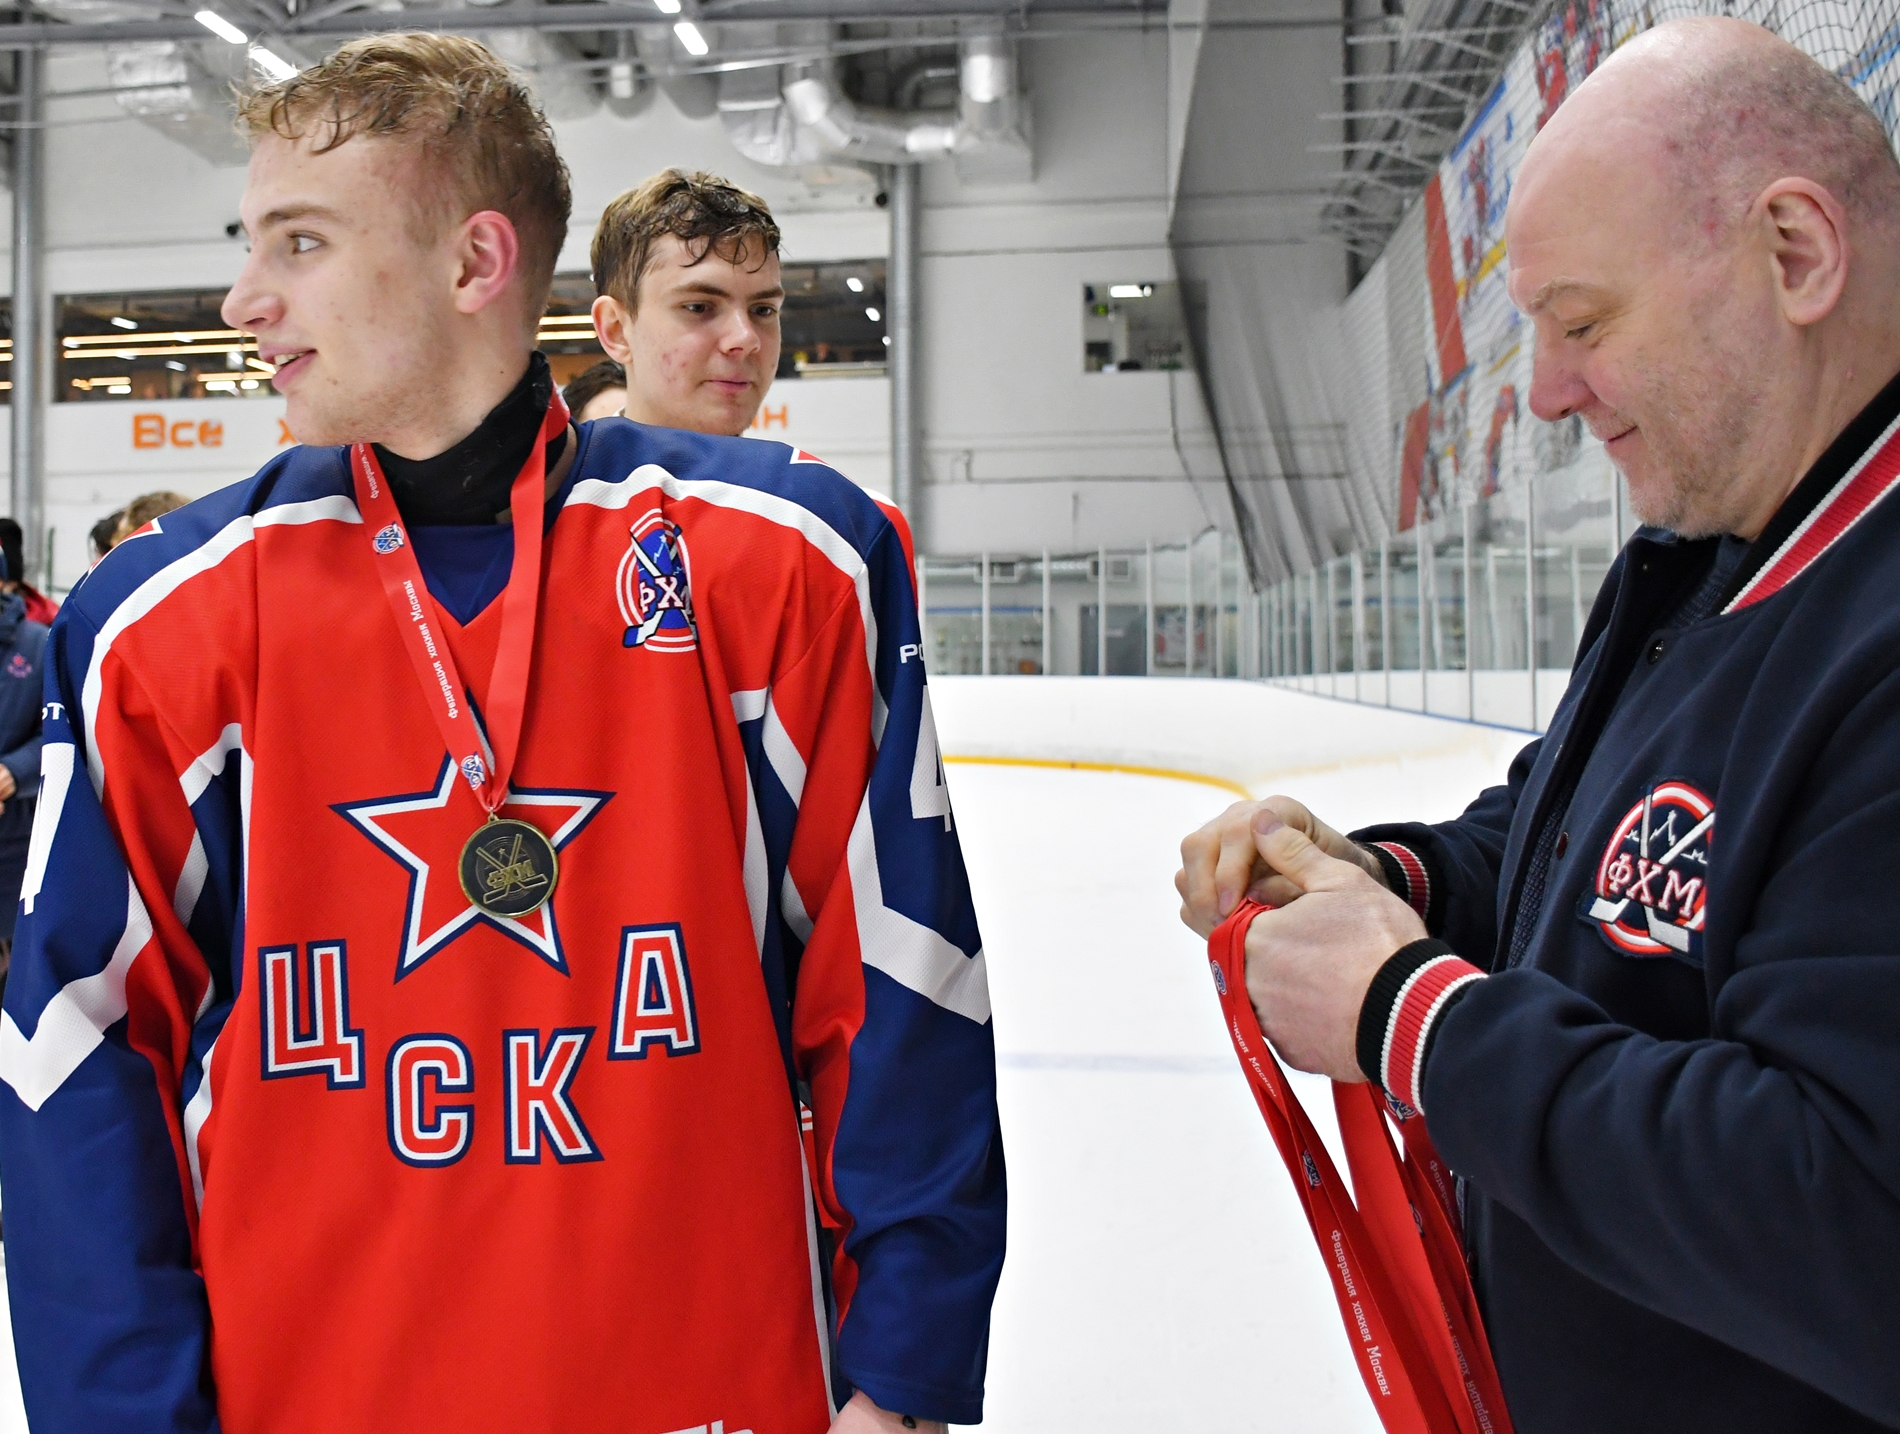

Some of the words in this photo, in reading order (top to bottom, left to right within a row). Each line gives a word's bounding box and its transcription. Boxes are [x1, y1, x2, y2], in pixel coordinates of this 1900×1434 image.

[403, 580, 424, 622] Москвы
[419, 623, 438, 658] хоккея
[433, 660, 459, 719] Федерация
[1606, 852, 1704, 919] ФХМ
[258, 922, 701, 1168] ЦСКА
[1248, 1056, 1277, 1098] Москвы
[1331, 1229, 1357, 1298] Федерация
[1351, 1301, 1372, 1342] хоккея
[1366, 1345, 1391, 1396] Москвы
[1466, 1381, 1494, 1434] едерация
